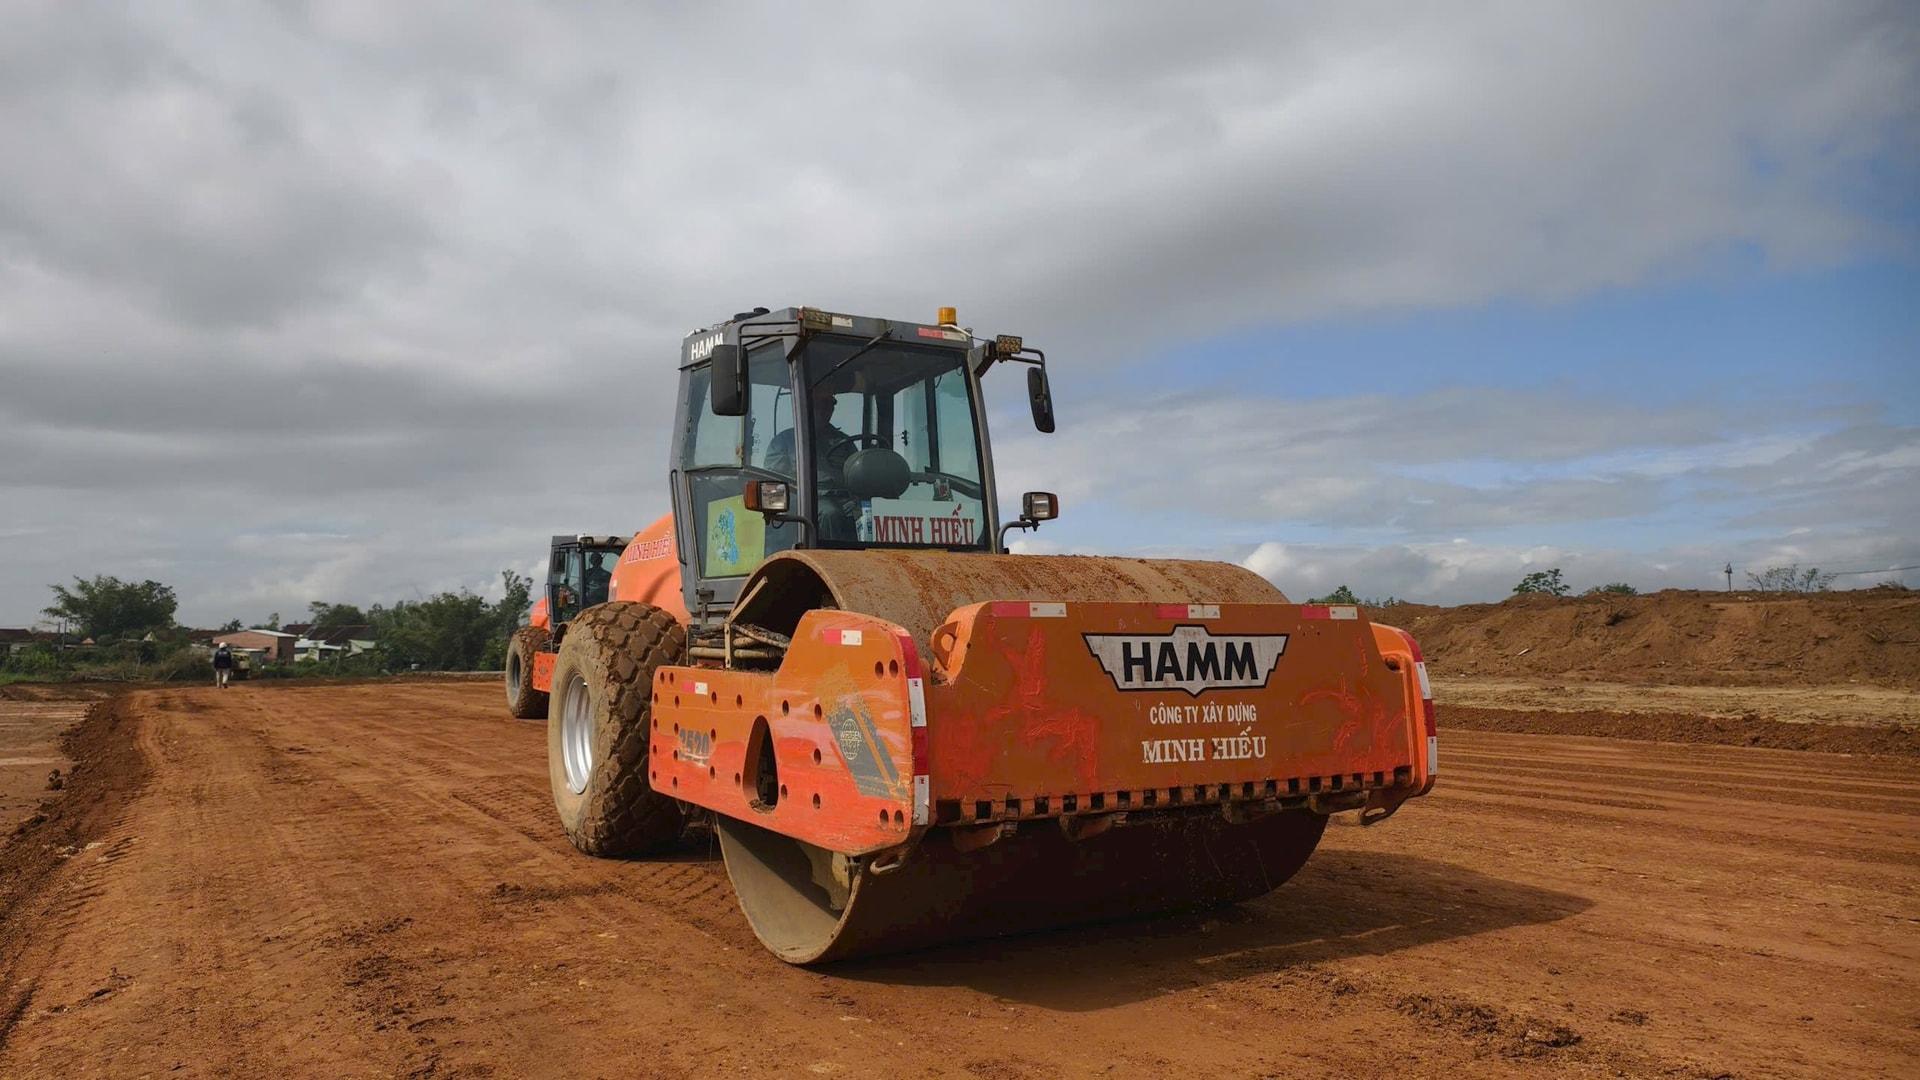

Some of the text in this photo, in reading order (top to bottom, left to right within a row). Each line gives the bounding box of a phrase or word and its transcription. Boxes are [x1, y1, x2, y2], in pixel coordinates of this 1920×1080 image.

[690, 332, 724, 361] HAMM
[874, 515, 925, 544] MINH
[929, 503, 974, 545] HIẾU
[1121, 641, 1259, 682] HAMM
[1149, 700, 1257, 726] CÔNG TY XÂY DỰNG
[1141, 726, 1267, 763] MINH HIẾU
